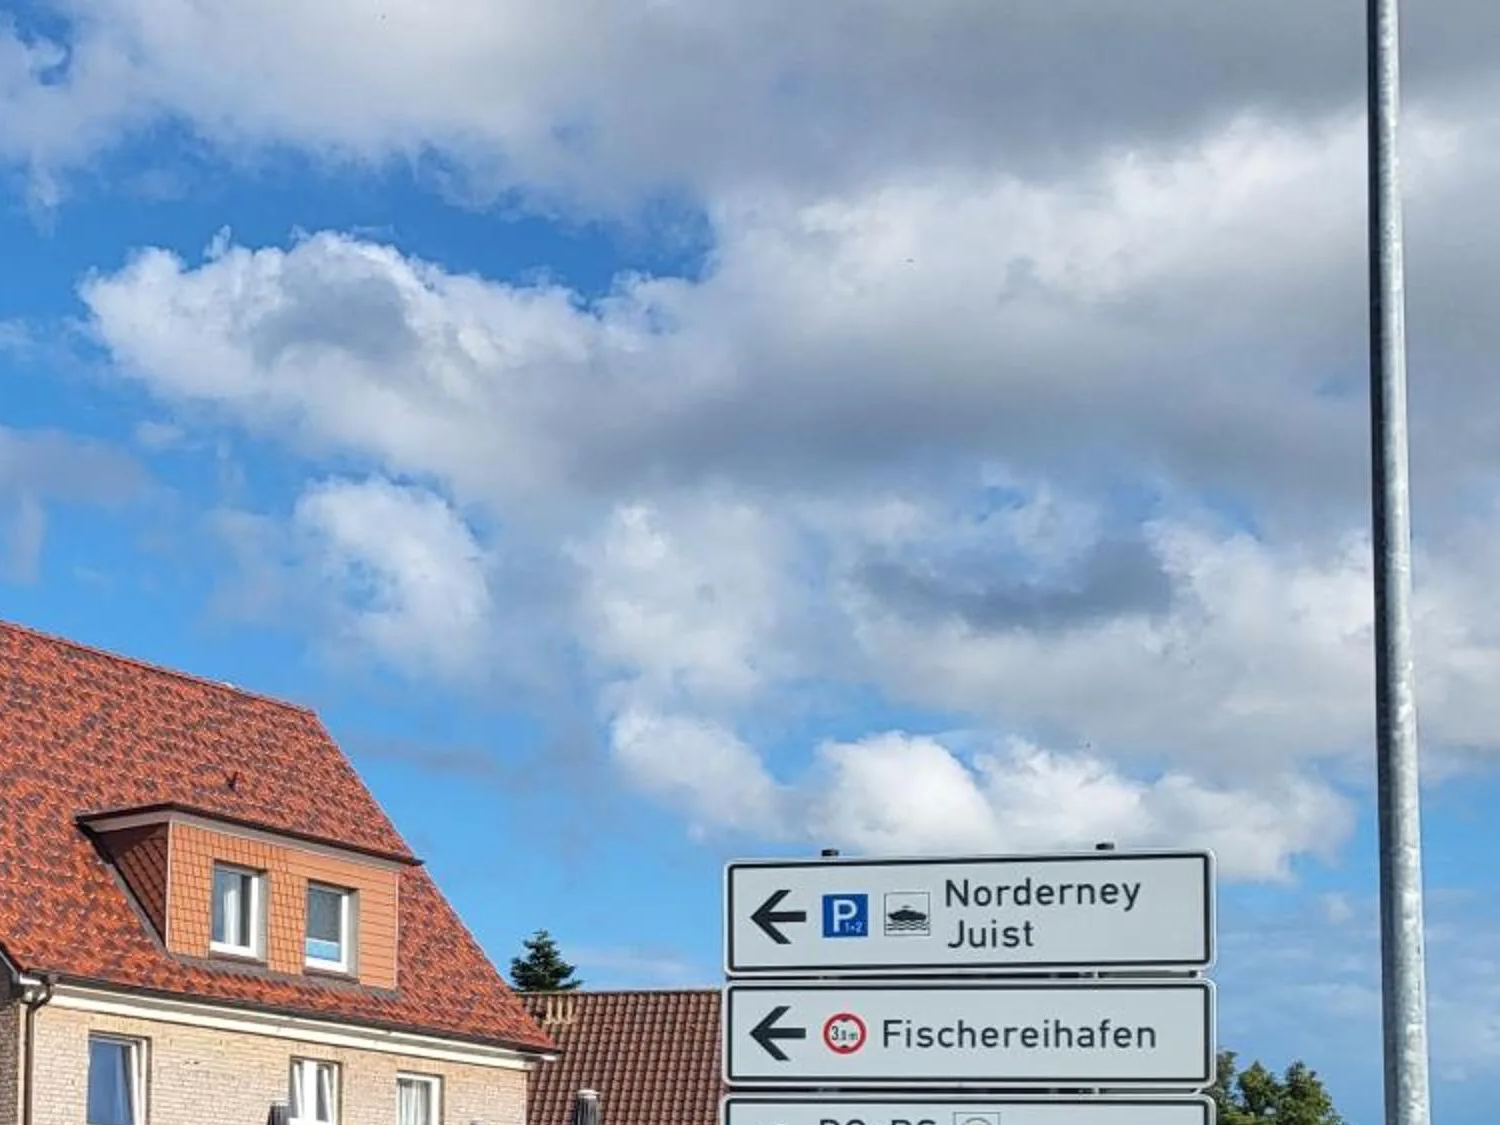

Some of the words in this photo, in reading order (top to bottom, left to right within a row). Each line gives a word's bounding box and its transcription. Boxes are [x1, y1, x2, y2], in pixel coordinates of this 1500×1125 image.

[945, 878, 1141, 911] Norderney
[833, 899, 858, 933] P
[947, 920, 1034, 949] Juist
[883, 1020, 1156, 1049] Fischereihafen
